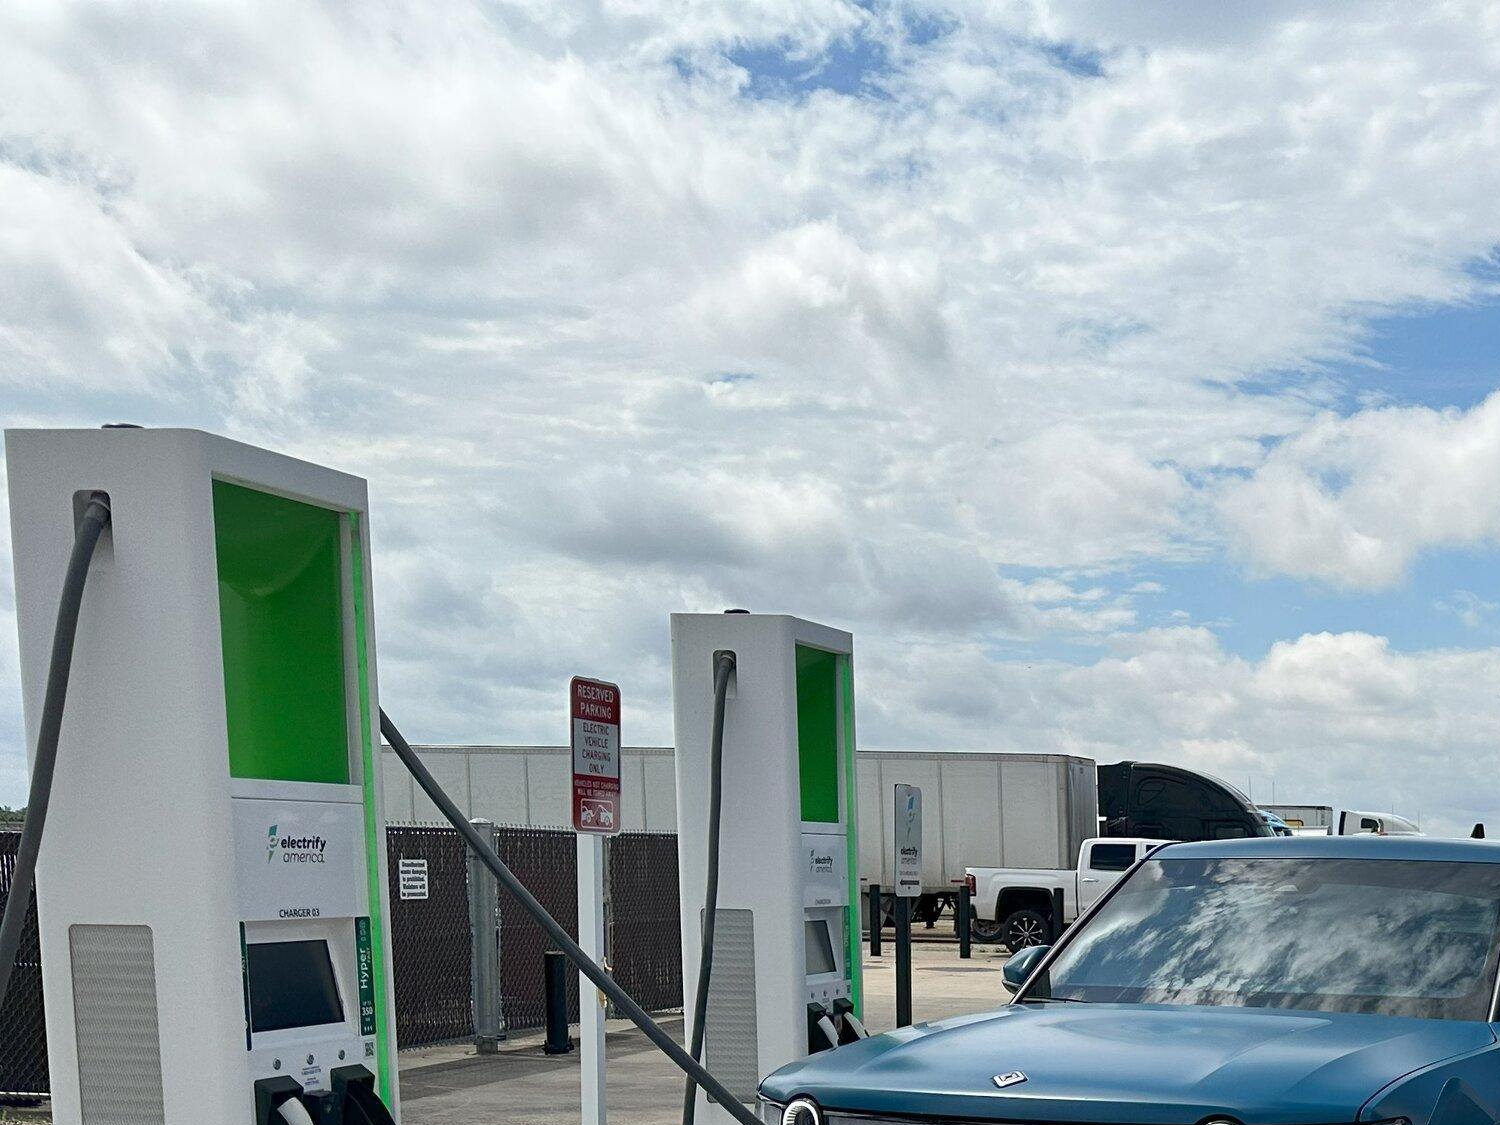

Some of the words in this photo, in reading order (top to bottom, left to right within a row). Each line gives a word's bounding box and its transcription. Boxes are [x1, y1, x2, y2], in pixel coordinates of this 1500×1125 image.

[578, 684, 614, 703] RESERVED
[580, 702, 612, 719] PARKING
[583, 722, 609, 735] ELECTRIC
[585, 737, 608, 749] VEHICLE
[582, 749, 611, 762] CHARGING
[589, 763, 605, 774] ONLY
[281, 835, 327, 852] electrify
[279, 909, 311, 918] CHARGER
[360, 947, 369, 989] Hyper
